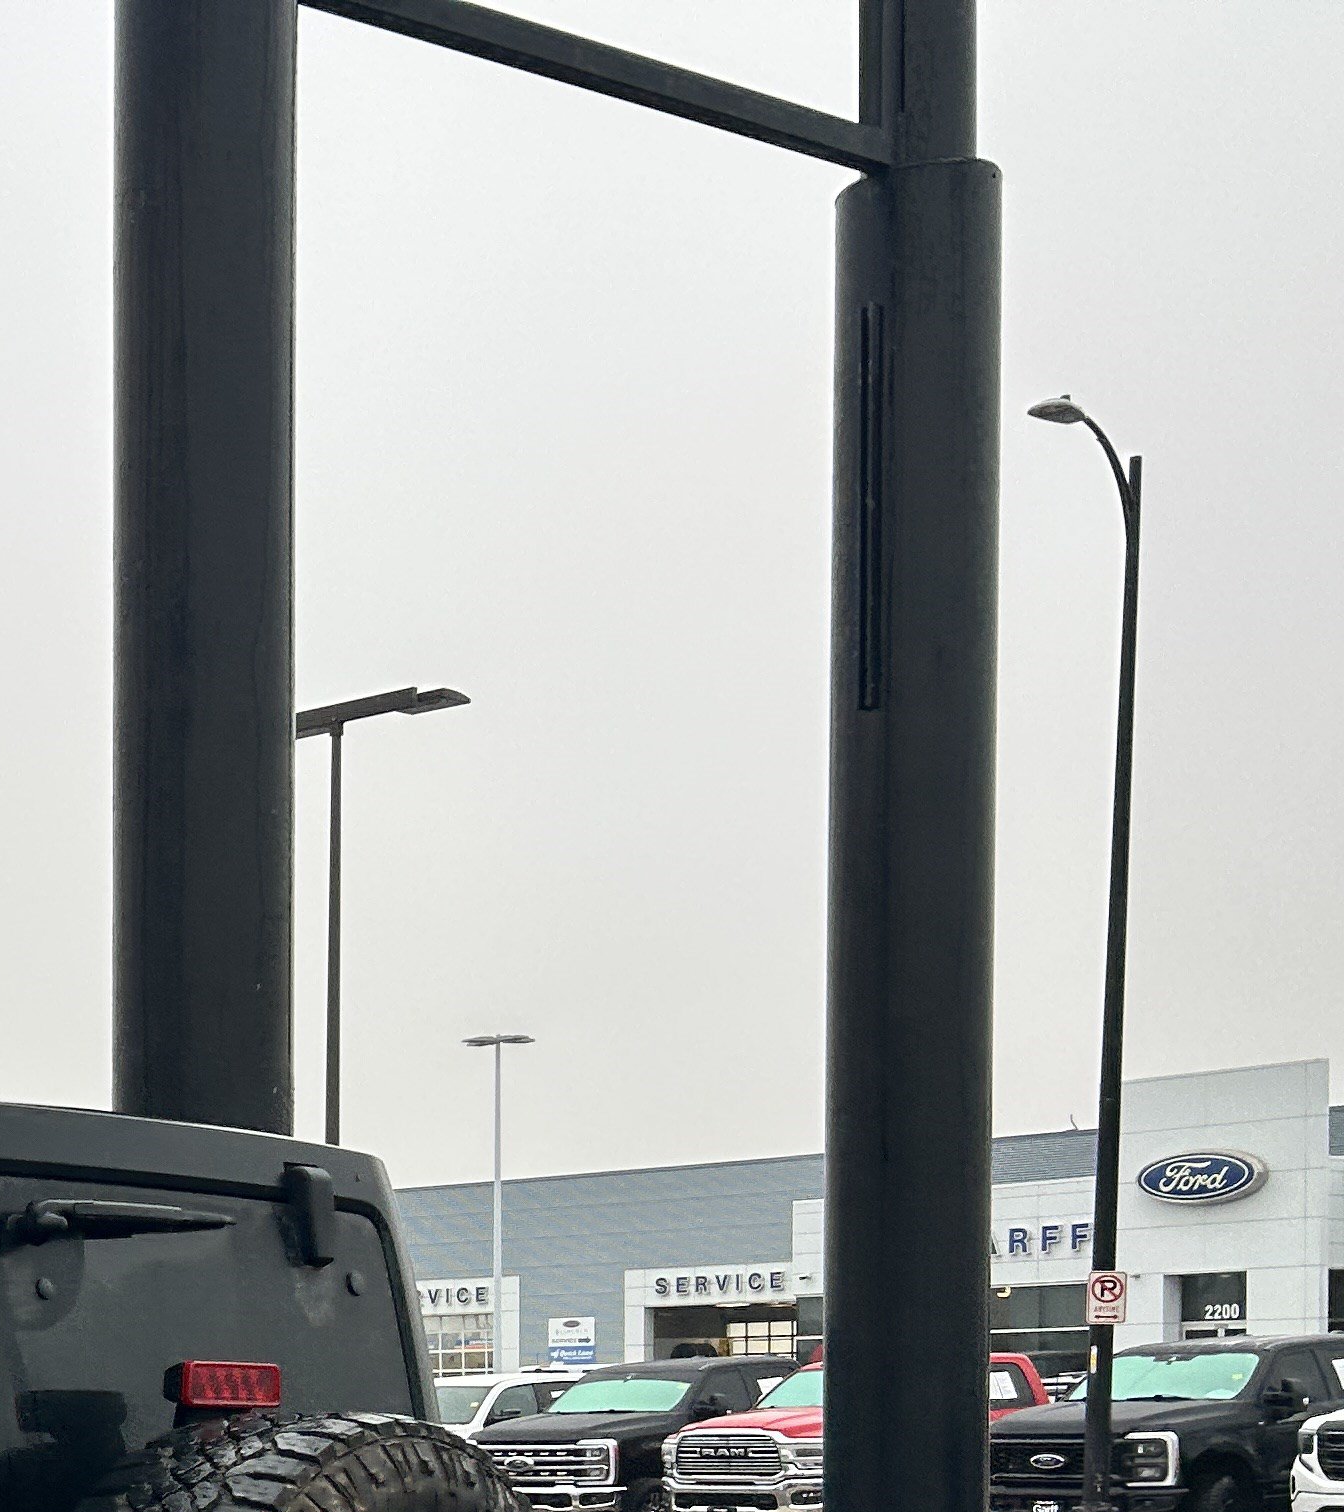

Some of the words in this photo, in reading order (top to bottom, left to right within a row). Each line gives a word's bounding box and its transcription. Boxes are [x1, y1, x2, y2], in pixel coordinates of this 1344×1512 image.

[1158, 1161, 1230, 1192] Ford
[655, 1271, 784, 1295] SERVICE
[419, 1286, 486, 1304] VICE
[1204, 1303, 1240, 1320] 2200
[701, 1448, 745, 1457] RAM
